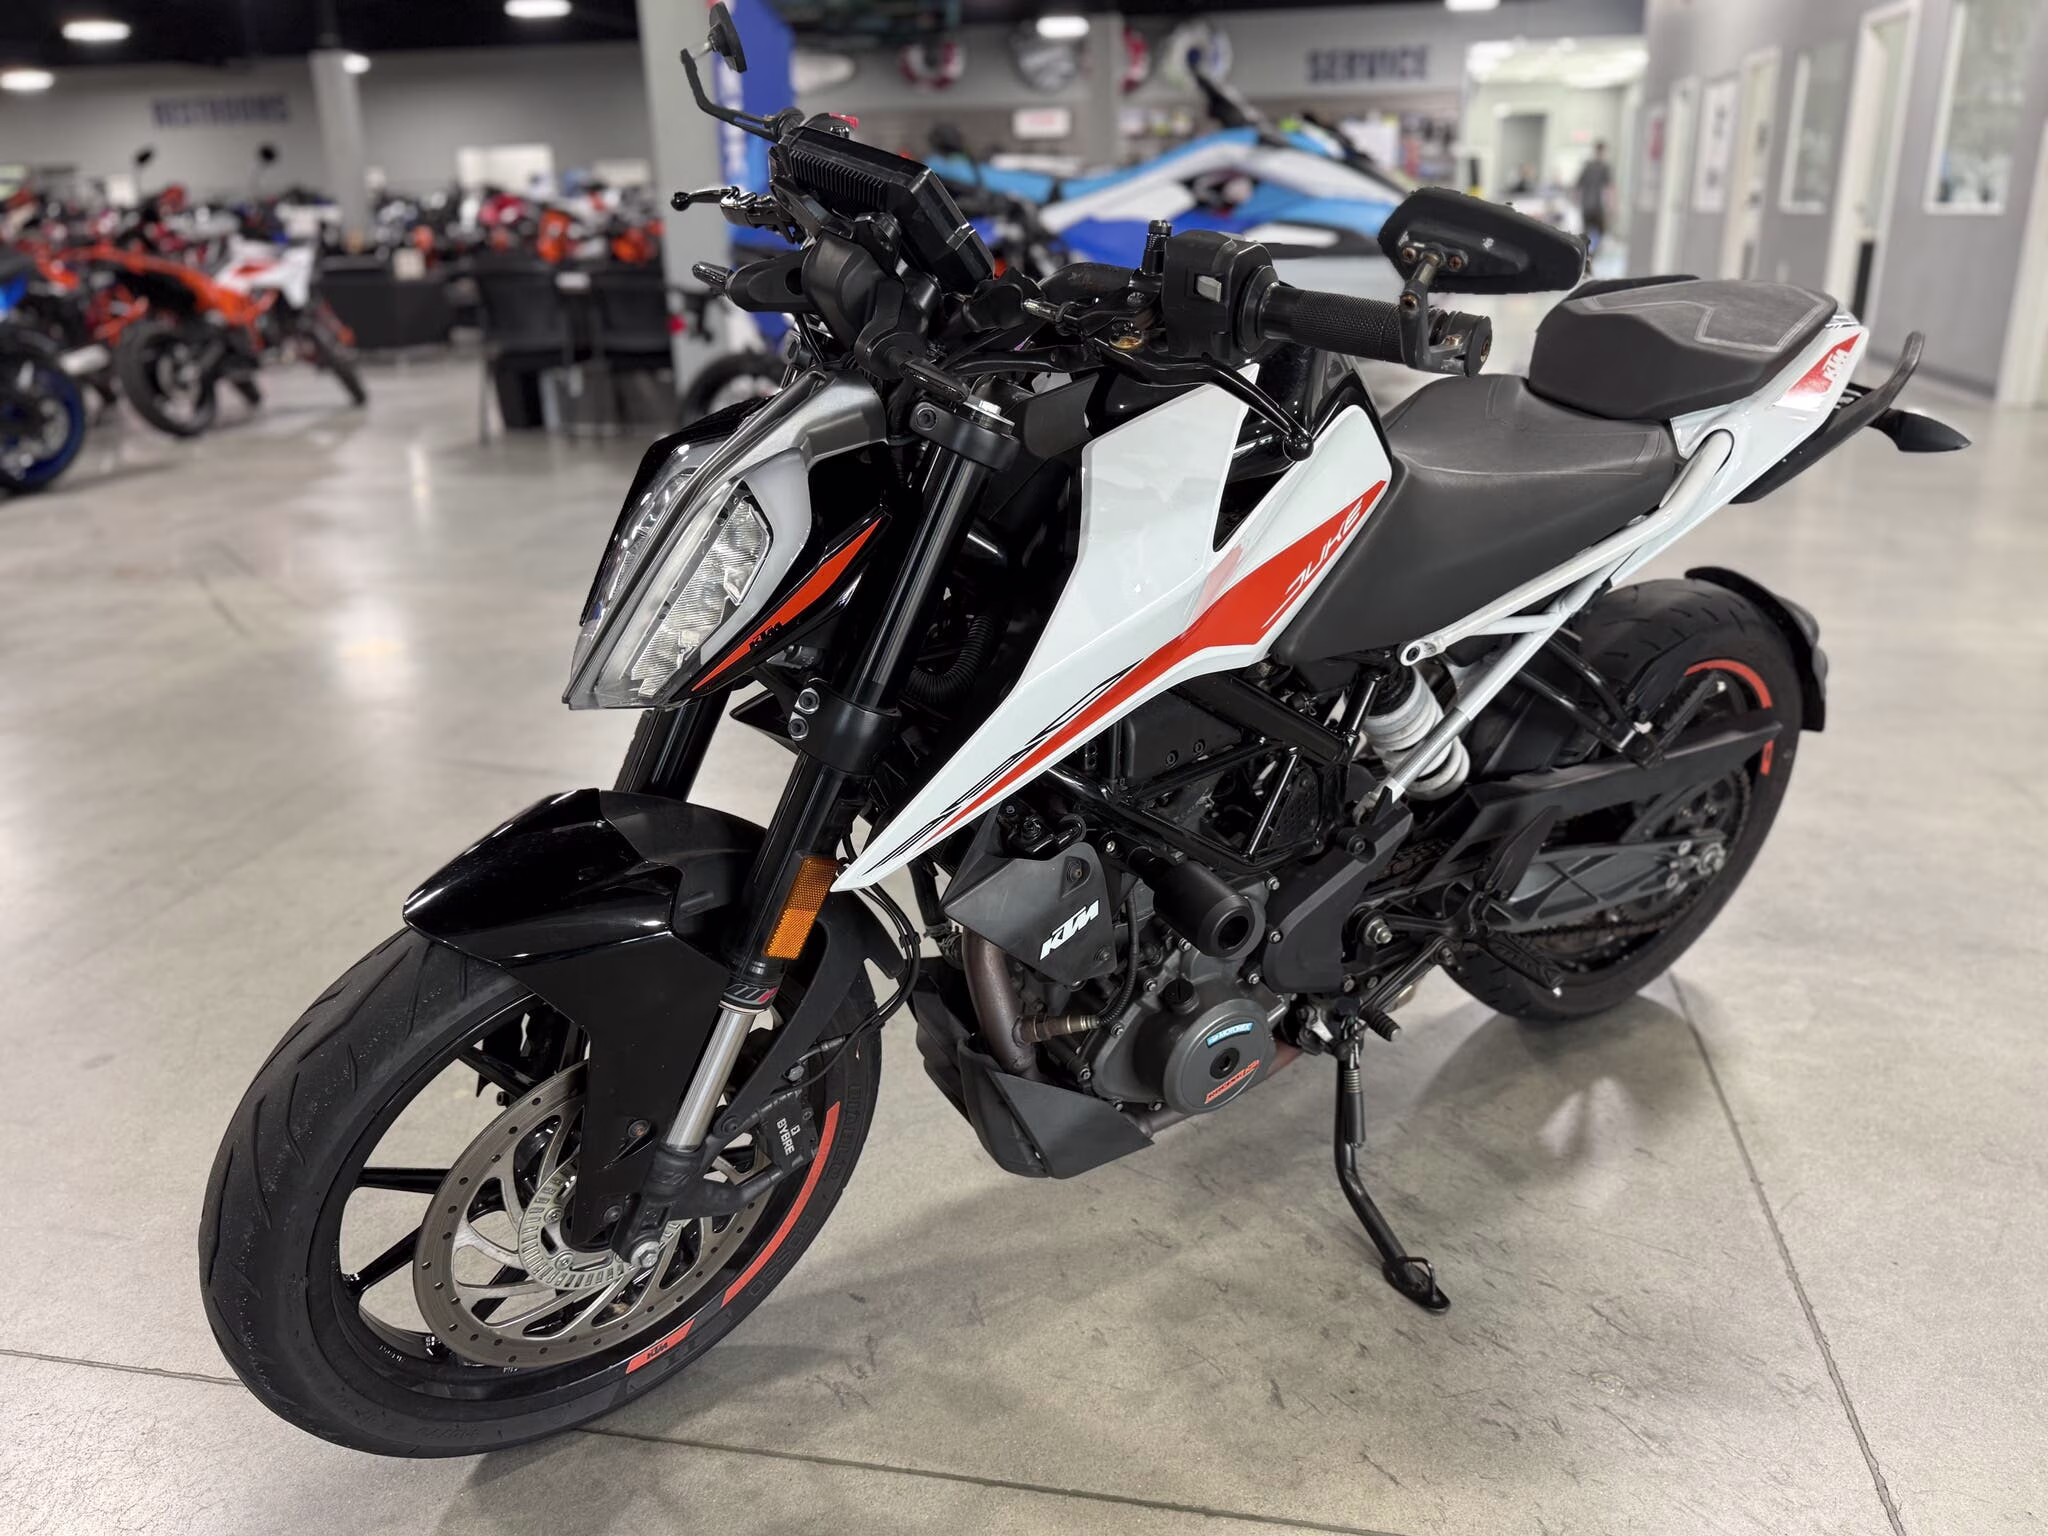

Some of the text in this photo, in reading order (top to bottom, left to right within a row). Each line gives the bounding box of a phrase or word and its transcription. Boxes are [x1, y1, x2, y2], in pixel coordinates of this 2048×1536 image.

[1305, 46, 1428, 82] SERVICE
[1261, 498, 1363, 629] DUKE
[1040, 899, 1099, 960] KTM
[776, 1117, 795, 1156] BYBRE
[646, 1342, 668, 1360] KTM
